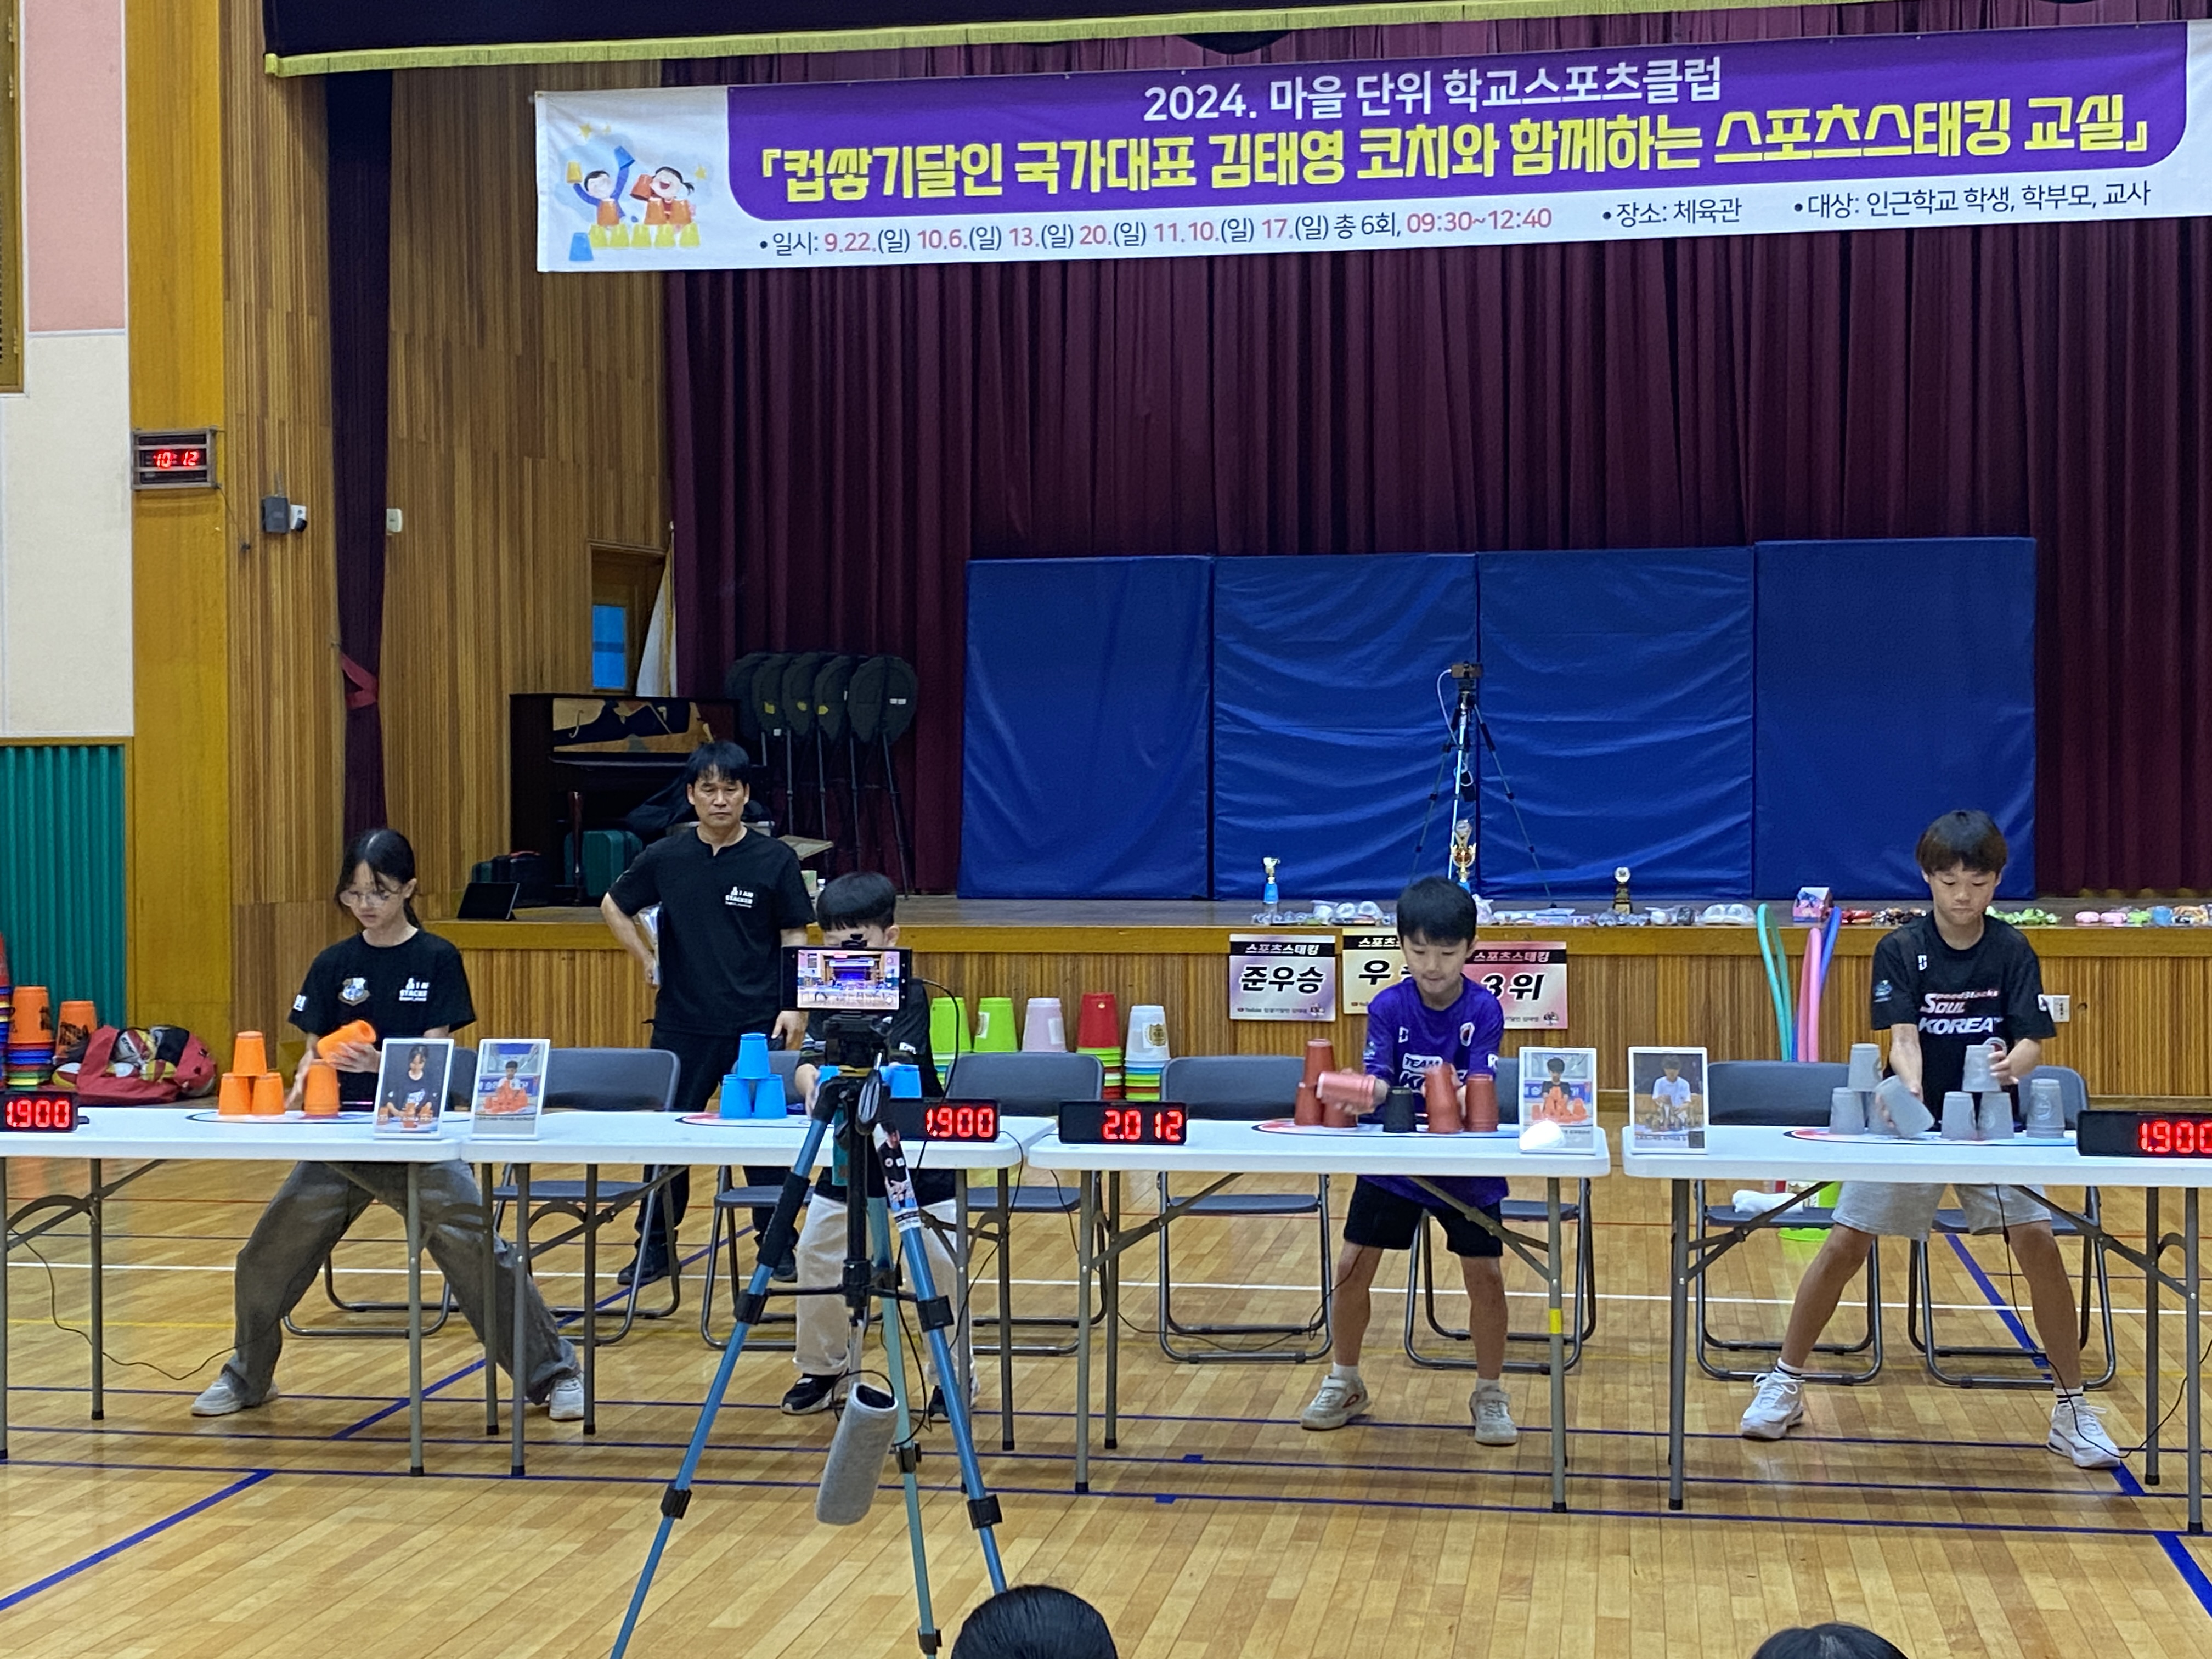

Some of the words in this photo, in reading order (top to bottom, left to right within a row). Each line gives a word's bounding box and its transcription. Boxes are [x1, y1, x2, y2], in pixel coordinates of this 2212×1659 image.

[1143, 82, 1258, 122] 2024.
[1269, 75, 1347, 121] 마을
[1356, 70, 1432, 117] 단위
[1442, 55, 1721, 113] 학교스포츠클럽
[1015, 135, 1198, 194] 국가대표
[1209, 128, 1345, 189] 김태영
[1356, 121, 1500, 180] 코치와
[1509, 113, 1703, 177] 함께하는
[1714, 98, 2011, 164] 스포츠스태킹
[1616, 201, 1668, 229] 장소:
[1672, 196, 1743, 225] 체육관
[1808, 191, 1860, 219] 대상:
[1866, 188, 1959, 217] 인근학교
[1963, 186, 2016, 214] 학생,
[2021, 184, 2097, 211] 학부모,
[2102, 180, 2152, 206] 교사
[772, 231, 819, 257] 일시:
[824, 228, 911, 255] 9.22.(일)
[917, 225, 1002, 252] 10.6.(일)
[1009, 223, 1075, 250] 13.(일)
[1079, 221, 1147, 248] 20.(일)
[1153, 217, 1255, 245] 11.10.(일)
[1261, 215, 1329, 242] 17.(일)
[1333, 213, 1357, 240] 총
[1361, 212, 1402, 239] 6회,
[1407, 207, 1552, 234] 09:30~12:40
[1245, 943, 1320, 956] 스포츠스태킹
[1358, 936, 1401, 947] 스포츠
[1474, 951, 1550, 963] 스포츠스태킹
[1240, 966, 1324, 994] 준우승
[1919, 1017, 1994, 1034] KOREA
